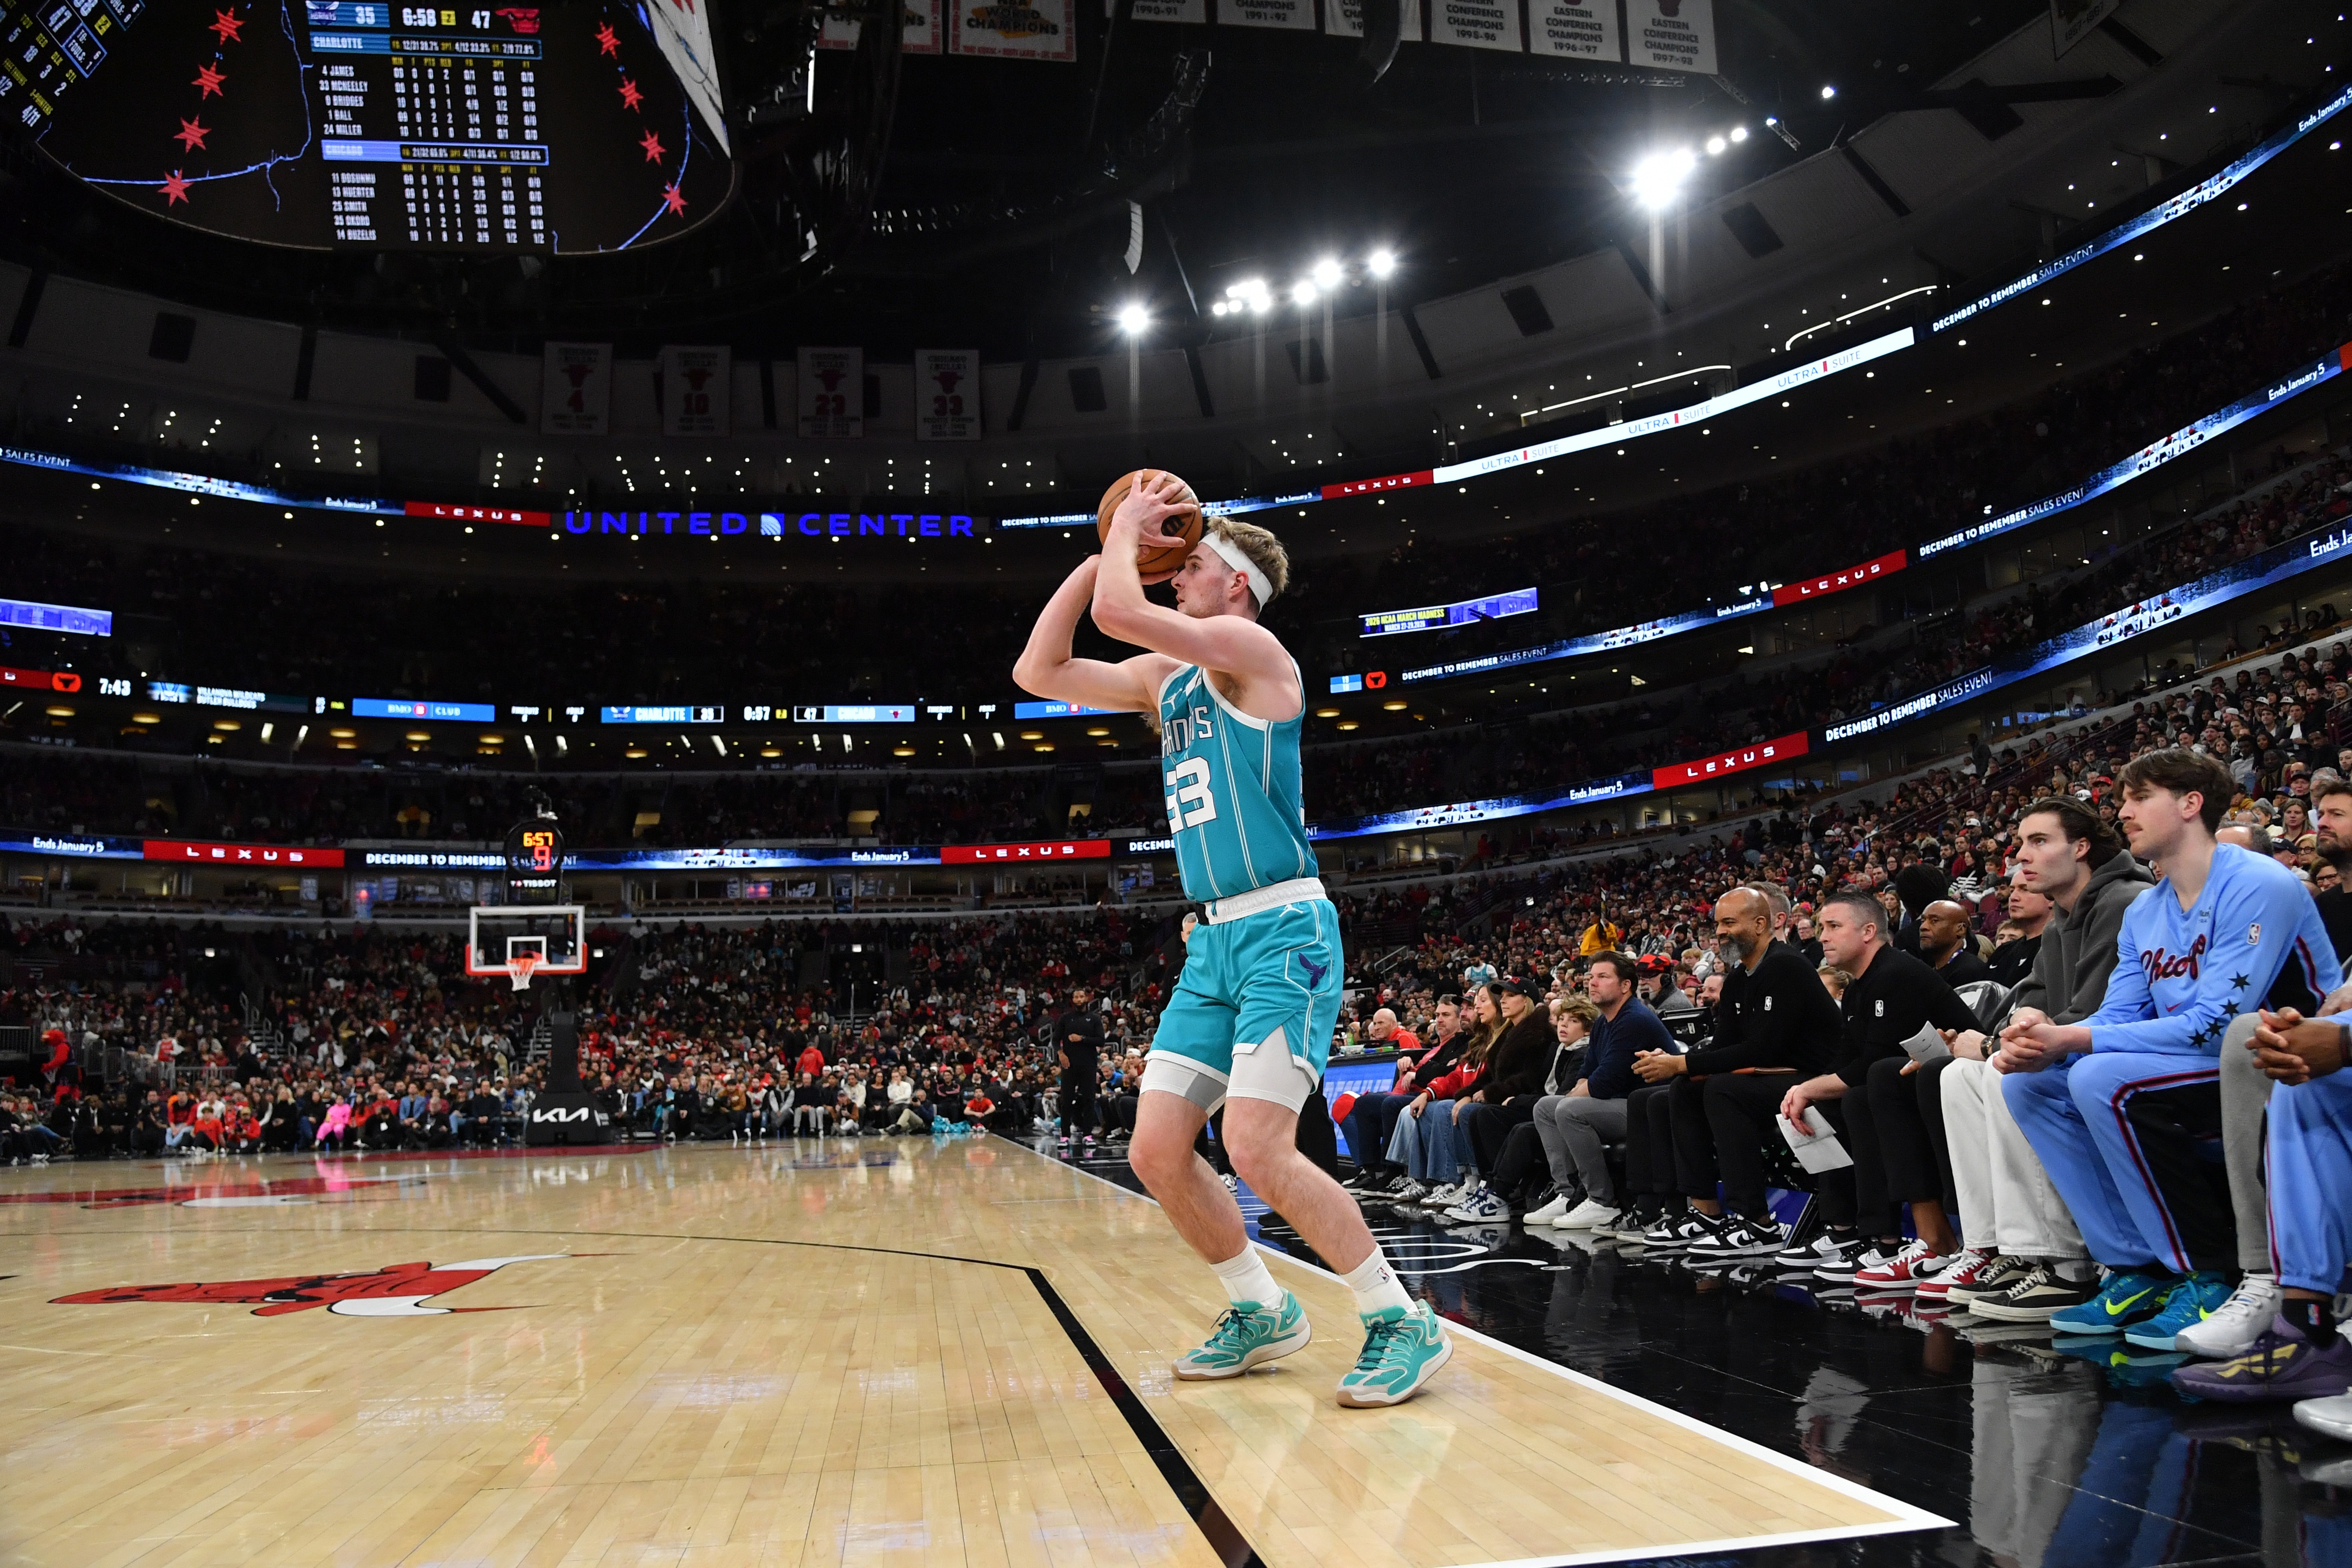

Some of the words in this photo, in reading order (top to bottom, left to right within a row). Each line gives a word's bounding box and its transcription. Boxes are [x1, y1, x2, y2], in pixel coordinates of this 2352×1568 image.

[355, 6, 375, 24] 35
[402, 7, 436, 27] 6:58
[472, 11, 490, 29] 47
[986, 5, 1040, 20] WORLD
[1135, 6, 1178, 16] 1990-91
[1244, 11, 1287, 21] 1991-92
[1446, 4, 1504, 19] CONFERENCE
[1554, 6, 1592, 19] EASTERN
[48, 5, 72, 33] 47
[967, 17, 1059, 35] CHAMPIONS
[1447, 16, 1504, 30] CHAMPIONS
[1546, 17, 1603, 31] CONFERENCE
[1652, 17, 1690, 30] EASTERN
[8, 27, 22, 42] 5
[1547, 29, 1603, 44] CHAMPIONS
[1644, 28, 1698, 44] CONFERENCE
[313, 36, 363, 49] CHARLOTTE
[1644, 40, 1698, 55] CHAMPIONS
[51, 51, 63, 66] BLK
[68, 39, 86, 63] FOULS:
[93, 51, 101, 60] 6
[40, 64, 52, 79] 3
[65, 69, 76, 83] STL
[322, 65, 327, 76] 4
[330, 65, 354, 77] JAMES
[443, 69, 449, 80] 2
[54, 82, 67, 96] 2
[319, 80, 329, 91] 33
[331, 80, 368, 92] MCNEELEY
[445, 83, 450, 95] 1
[446, 98, 451, 110] 1
[2299, 114, 2317, 132] Ends
[2317, 94, 2346, 120] January
[2346, 87, 2352, 99] 5
[22, 105, 41, 127] 4/11
[328, 109, 333, 120] 1
[334, 109, 353, 121] BALL
[432, 111, 438, 123] 2
[447, 112, 453, 123] 2
[323, 124, 334, 135] 24
[335, 124, 362, 135] MILLER
[417, 126, 422, 137] 1
[332, 173, 339, 183] 11
[438, 188, 444, 199] 4
[440, 216, 447, 228] 2
[1932, 303, 1977, 332] DECEMBER
[1978, 297, 1990, 310] TO
[1990, 273, 2038, 303] REMEMBER
[2039, 260, 2064, 280] SALES
[2065, 245, 2094, 267] EVENT
[1778, 367, 1819, 388] ULTRA
[1832, 350, 1861, 368] SUITE
[2269, 385, 2287, 401] Ends
[2287, 370, 2317, 392] January
[2318, 362, 2325, 375] 5
[683, 393, 709, 414] 10
[816, 394, 846, 415] 23
[934, 395, 963, 416] 33
[1628, 418, 1670, 434] ULTRA
[1683, 405, 1711, 421] SUITE
[6, 449, 35, 463] SALES
[38, 454, 70, 467] EVENT
[1481, 455, 1519, 470] ULTRA
[1532, 443, 1559, 459] SUITE
[1344, 477, 1412, 493] LEXUS
[435, 506, 522, 521] LEXUS
[1002, 518, 1039, 527] DECEMBER
[1050, 514, 1087, 524] REMEMBER
[565, 512, 748, 535] UNITED
[798, 513, 974, 537] CENTER
[1920, 532, 1964, 557] DECEMBER
[1966, 528, 1978, 539] TO
[1978, 510, 2027, 535] REMEMBER
[2028, 500, 2054, 517] SALES
[2056, 488, 2084, 507] EVENT
[2310, 534, 2340, 558] Ends
[1801, 563, 1880, 595] LEXUS
[1717, 606, 1732, 618] Ends
[1732, 600, 1757, 616] January
[1756, 598, 1762, 607] 5
[1365, 617, 1380, 627] 2026
[1418, 608, 1445, 620] MADNESS
[1402, 665, 1442, 681] DECEMBER
[1444, 664, 1455, 673] TO
[1455, 656, 1498, 671] REMEMBER
[1499, 652, 1522, 663] SALES
[1522, 647, 1547, 660] EVENT
[99, 678, 131, 696] 7:43
[435, 706, 461, 717] CLUB
[635, 707, 686, 721] CHARLOTTE
[700, 708, 714, 721] 35
[743, 705, 771, 721] 6:57
[803, 707, 817, 720] 47
[1045, 705, 1067, 713] BMO
[1825, 716, 1878, 741] DECEMBER
[1878, 711, 1890, 726] TO
[1891, 693, 1938, 721] REMEMBER
[1938, 682, 1963, 703] SALES
[1964, 670, 1992, 693] EVENT
[1687, 746, 1774, 777] LEXUS
[1570, 789, 1587, 800] Ends
[1587, 784, 1617, 798] January
[1616, 781, 1623, 792] 5
[33, 837, 57, 850] Ends
[57, 839, 95, 854] January
[95, 841, 104, 852] 5
[523, 832, 554, 847] 6:57
[187, 846, 303, 862] LEXUS
[366, 853, 428, 865] DECEMBER
[431, 854, 447, 865] TO
[534, 845, 550, 871] 9
[852, 851, 871, 862] Ends
[871, 851, 902, 863] January
[902, 851, 909, 861] 5
[975, 845, 1074, 858] LEXUS
[522, 879, 557, 887] TISSOT
